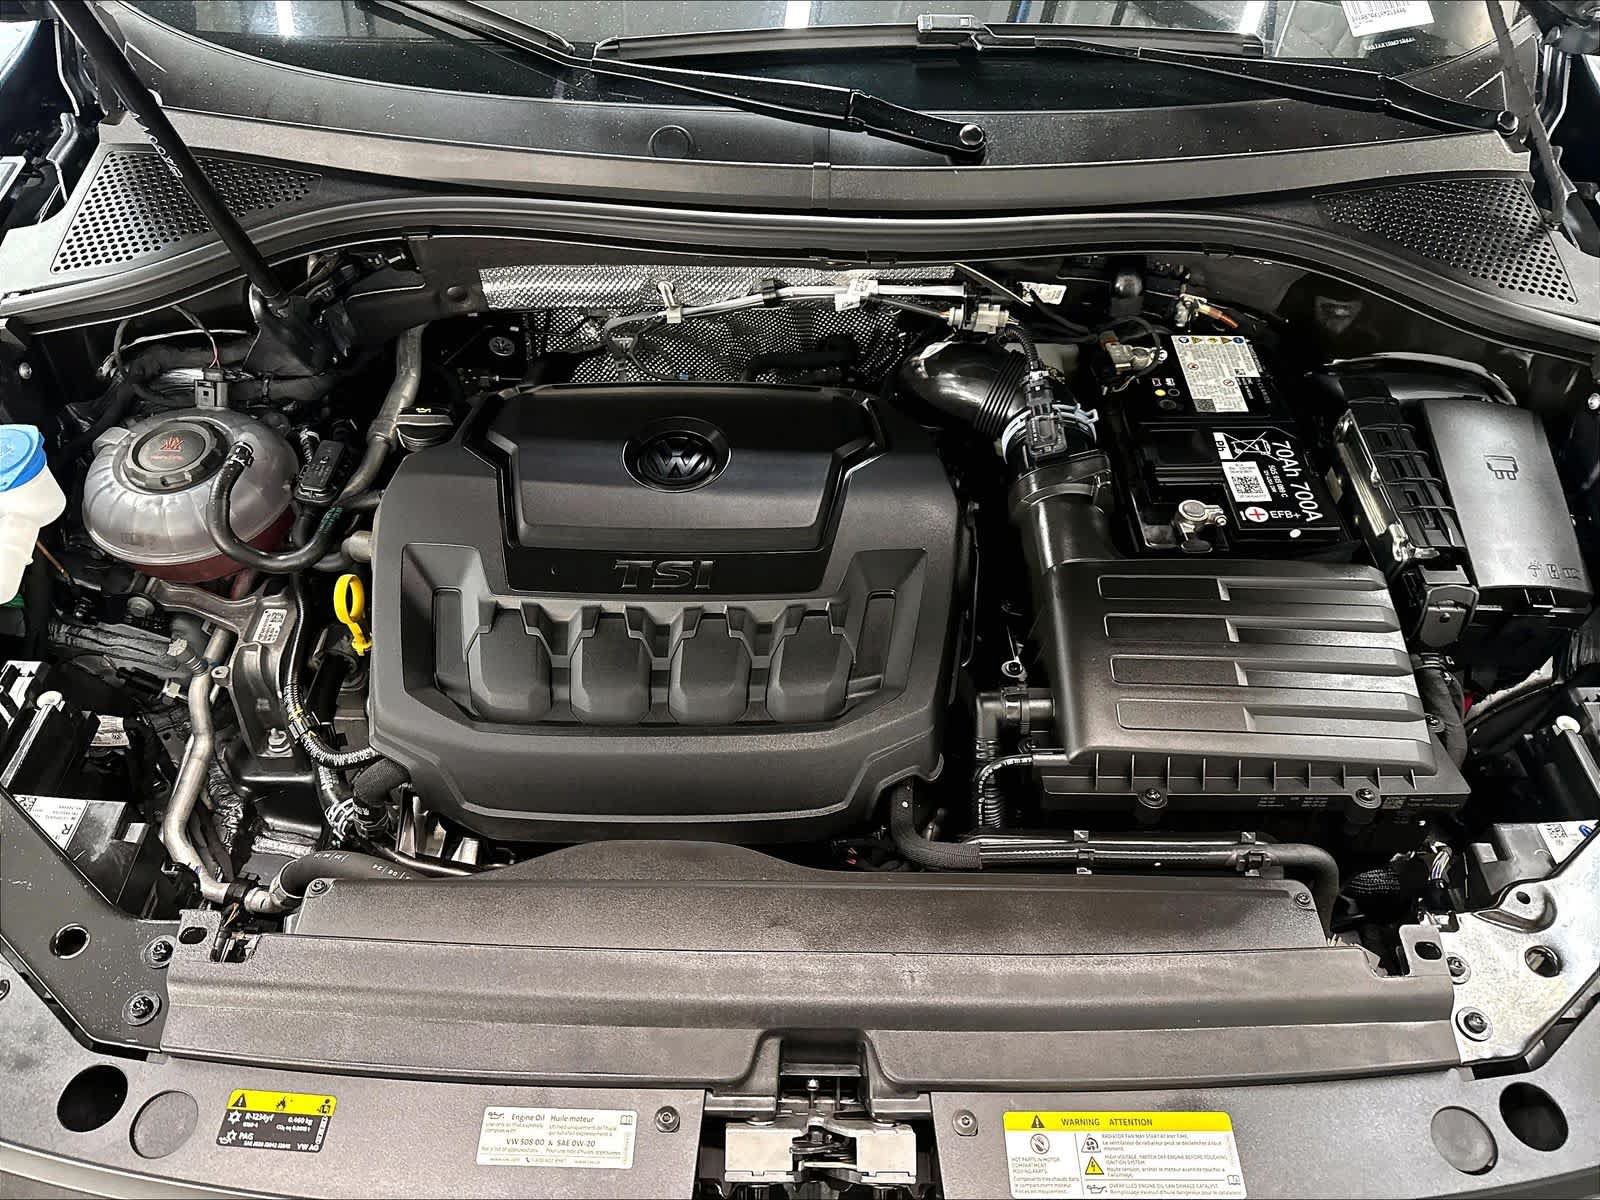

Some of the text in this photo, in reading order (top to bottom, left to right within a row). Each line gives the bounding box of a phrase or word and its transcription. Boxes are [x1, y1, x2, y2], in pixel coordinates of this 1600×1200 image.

[1272, 440, 1323, 522] 70Ah 700A
[1269, 510, 1301, 519] EFB+
[614, 559, 716, 590] TSI
[511, 1113, 534, 1122] Engine
[569, 1115, 595, 1123] moteur
[1060, 1118, 1153, 1127] WARNING ATTENTION
[520, 1138, 533, 1146] 508
[534, 1138, 545, 1146] 00
[557, 1139, 570, 1147] SAE
